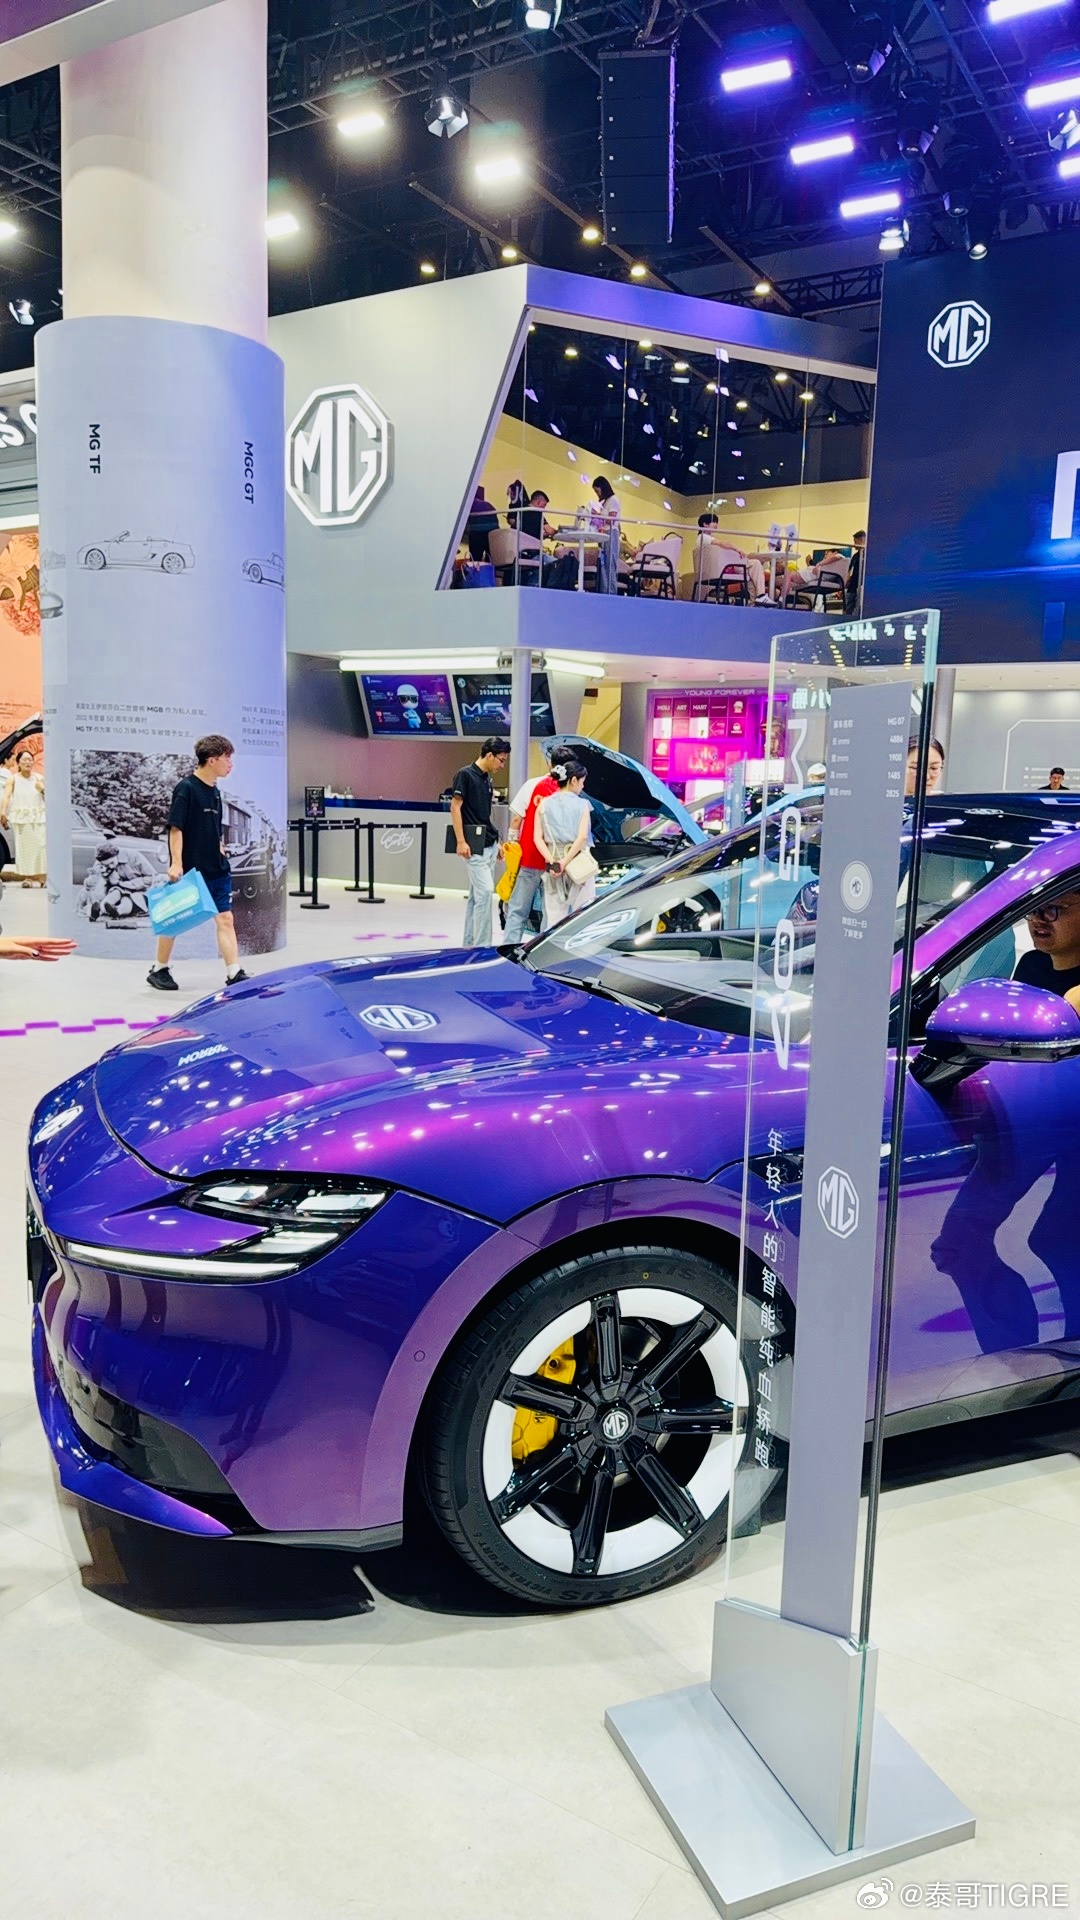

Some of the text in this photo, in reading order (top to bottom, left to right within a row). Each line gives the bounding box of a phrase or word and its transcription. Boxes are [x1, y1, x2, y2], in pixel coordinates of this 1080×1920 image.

[932, 306, 985, 362] MG
[89, 424, 101, 474] MG TF
[244, 441, 254, 505] MGC GT
[293, 397, 378, 514] MG
[887, 771, 901, 780] 1485
[888, 753, 903, 762] 1900
[885, 789, 900, 798] 2825
[820, 1171, 856, 1233] MG
[605, 1413, 626, 1437] MG
